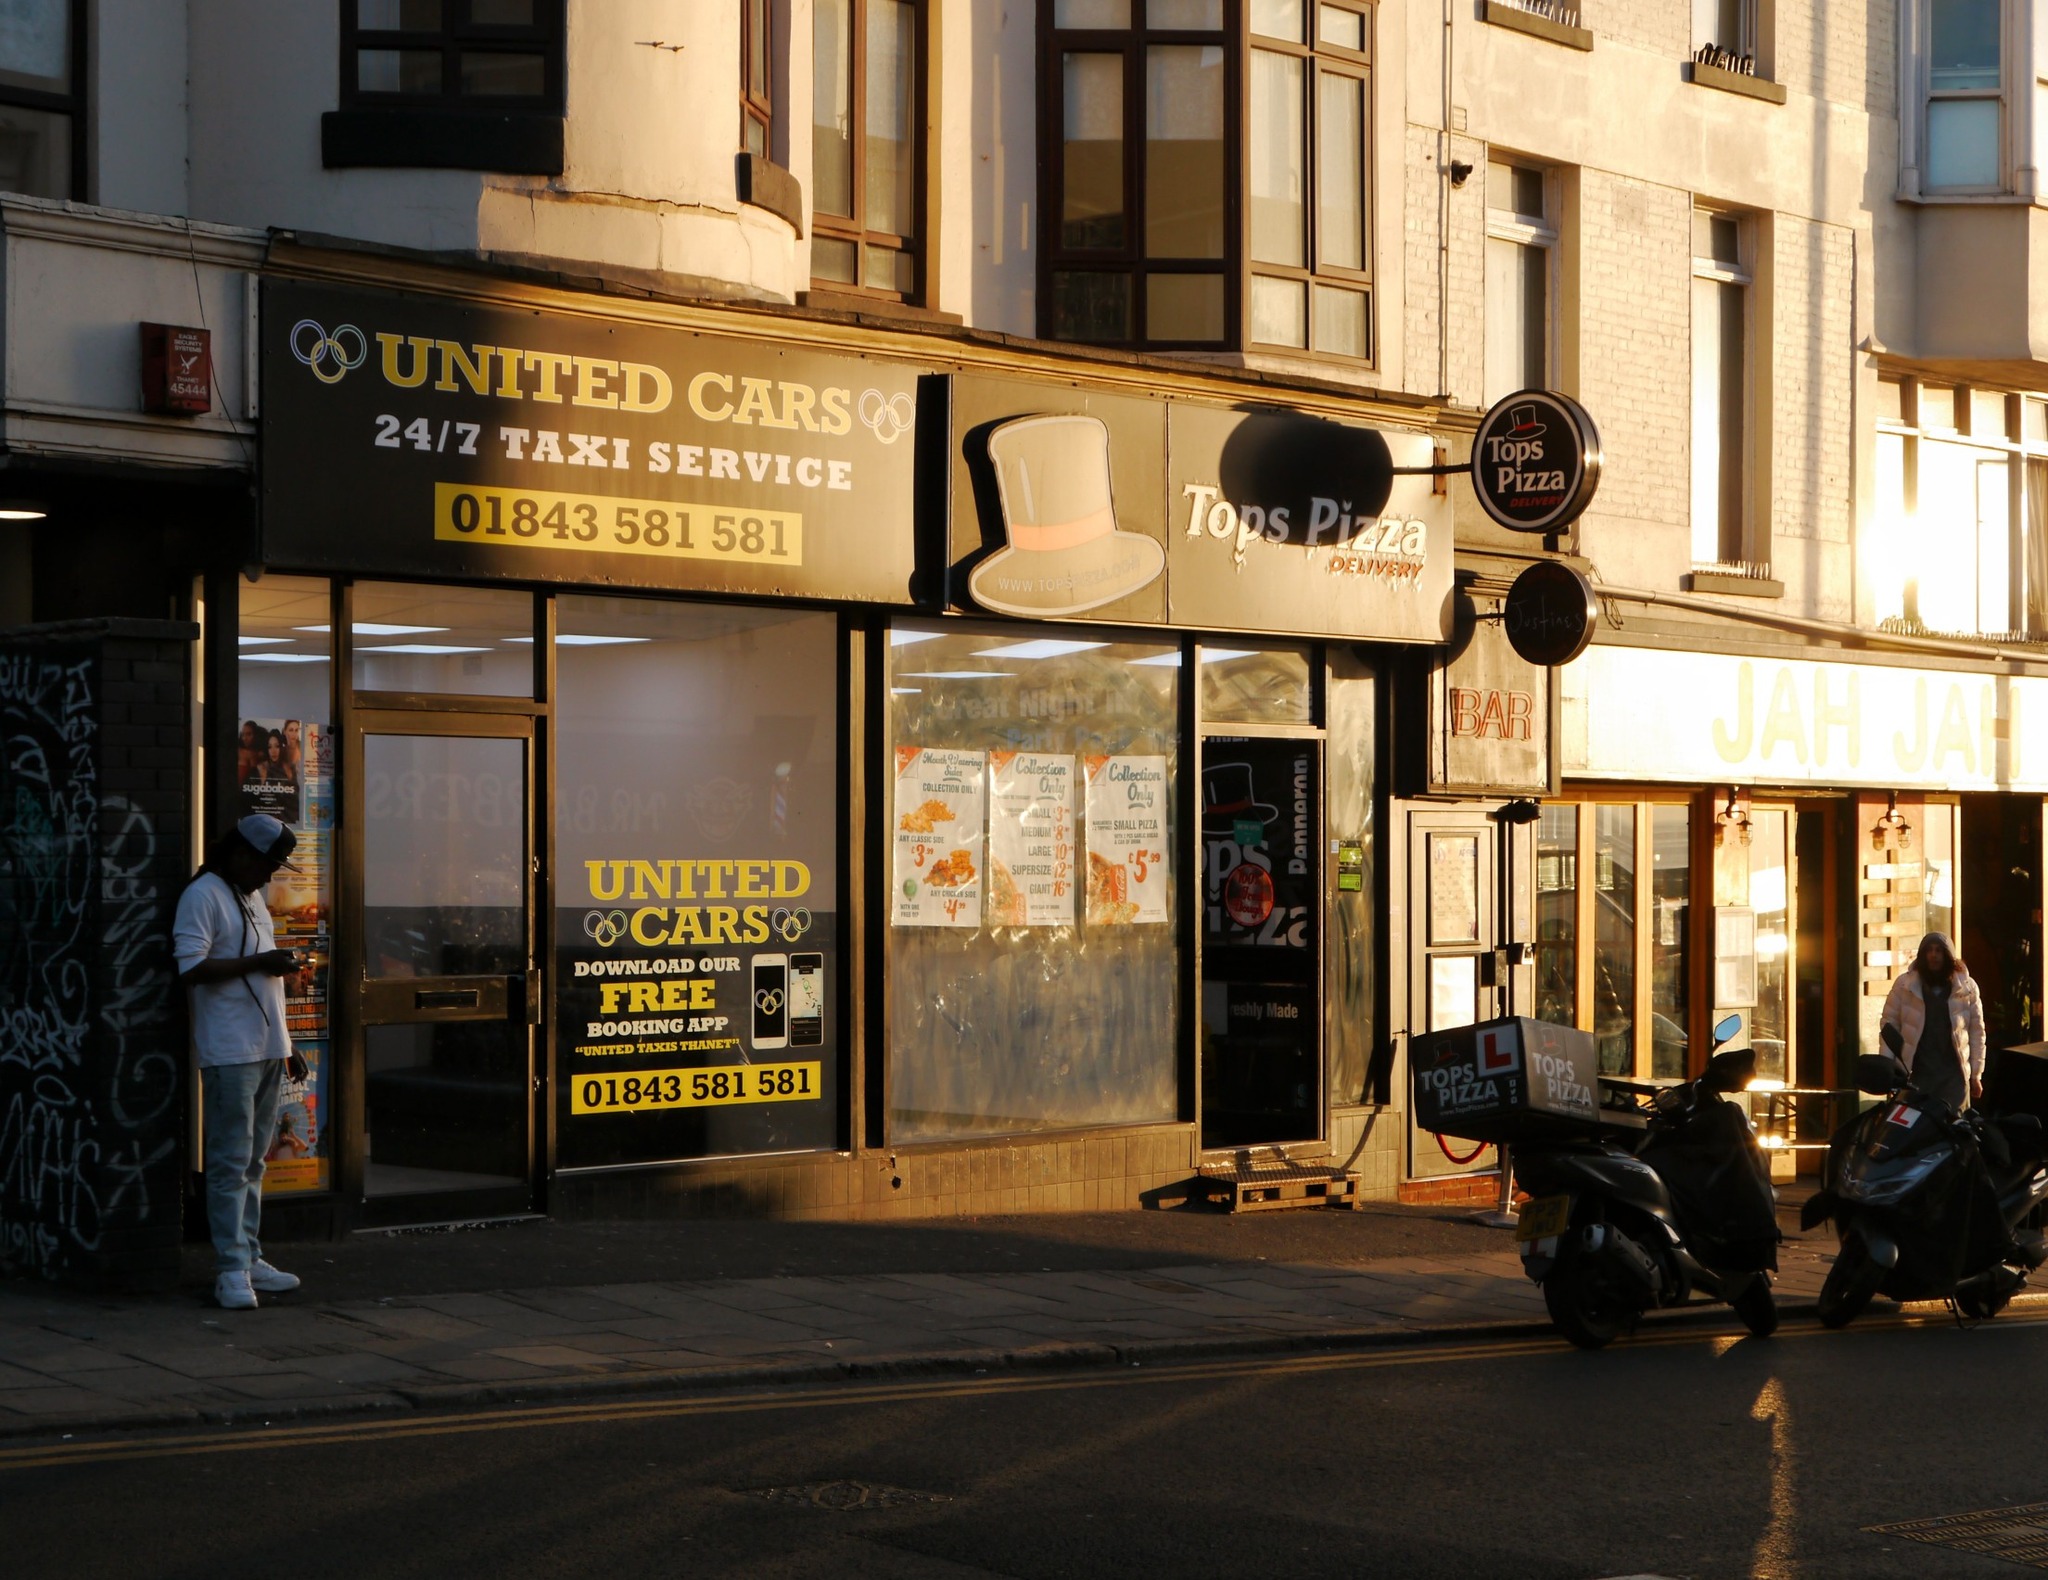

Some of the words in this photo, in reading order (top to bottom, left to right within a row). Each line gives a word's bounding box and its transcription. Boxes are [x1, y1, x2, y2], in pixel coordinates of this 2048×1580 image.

[174, 345, 202, 353] SYSTEMS
[170, 383, 207, 397] 45444
[375, 331, 673, 414] UNITED
[688, 371, 853, 437] CARS
[374, 414, 481, 456] 24/7
[500, 426, 630, 470] TAXI
[648, 442, 853, 491] SERVICE
[1486, 436, 1544, 470] Tops
[1497, 466, 1566, 494] Pizza
[1509, 495, 1565, 509] DELIVERY
[450, 493, 599, 542] 01843
[613, 507, 695, 549] 581
[711, 514, 789, 557] 581
[1182, 483, 1290, 563] Tops
[1304, 496, 1427, 557] Pizza
[1328, 555, 1424, 579] DELIVERY
[1019, 688, 1096, 723] Night
[1449, 686, 1532, 741] BAR
[1711, 659, 1861, 769] JAH
[1892, 675, 2022, 780] JAH
[1015, 756, 1067, 776] Collection
[1108, 762, 1161, 782] Collection
[241, 781, 295, 795] sugababes
[922, 783, 960, 793] COLLECTION
[961, 785, 978, 795] ONLY
[1039, 776, 1066, 801] Only
[1127, 782, 1154, 808] Only
[1021, 826, 1052, 838] MEDIUM
[1113, 820, 1137, 831] SMALL
[1138, 819, 1158, 830] PIZZA
[899, 834, 910, 843] ANY
[910, 835, 932, 843] CLASSIC
[933, 836, 944, 844] SIDE
[1028, 845, 1052, 857] LARGE
[911, 844, 934, 867] £3.99
[1128, 849, 1161, 883] £5.99
[584, 859, 812, 901] UNITED
[1011, 864, 1052, 876] SUPERSIZE
[965, 890, 977, 899] SIDE
[1029, 883, 1051, 895] GIANT
[629, 905, 770, 947] CARS
[574, 958, 695, 977] DOWNLOAD
[699, 957, 741, 973] OUR
[600, 979, 716, 1014] FREE
[1230, 1002, 1263, 1021] reshly
[1266, 1002, 1299, 1019] Made
[587, 1018, 684, 1038] BOOKING
[687, 1016, 729, 1032] APP
[636, 1041, 678, 1055] TAXIS
[1484, 1033, 1512, 1070] L
[1420, 1062, 1475, 1092] TOPS
[1532, 1052, 1575, 1083] TOPS
[582, 1075, 682, 1108] 01843
[691, 1071, 747, 1099] 581
[757, 1067, 811, 1096] 581
[1438, 1079, 1500, 1108] PIZZA
[1547, 1077, 1593, 1108] PIZZA
[1891, 1103, 1910, 1126] L
